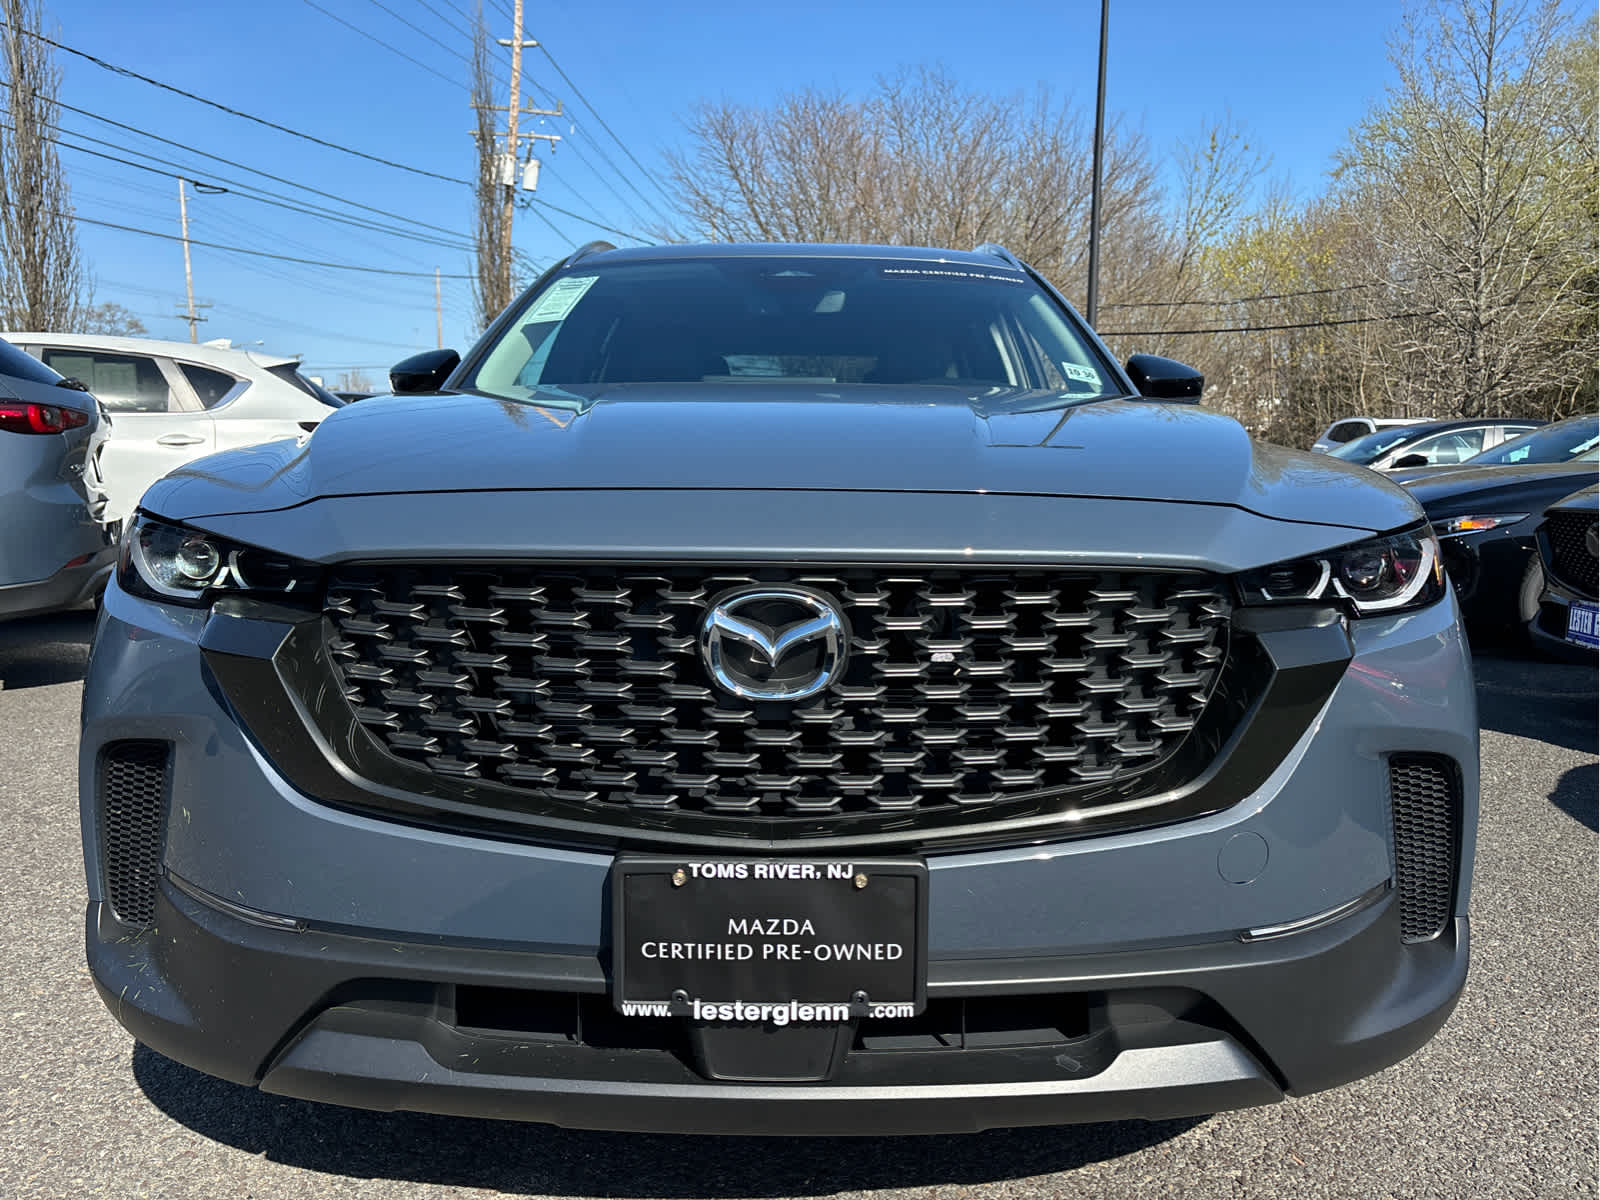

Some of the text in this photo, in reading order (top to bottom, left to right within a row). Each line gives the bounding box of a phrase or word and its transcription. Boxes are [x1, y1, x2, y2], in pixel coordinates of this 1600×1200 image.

[1569, 608, 1593, 635] LESTER
[688, 862, 854, 881] TOMS RIVER, NJ
[727, 918, 816, 936] MAZDA
[641, 942, 903, 961] CERTIFIED PRE-OWNED
[622, 999, 914, 1026] www. lesterglenn .com
